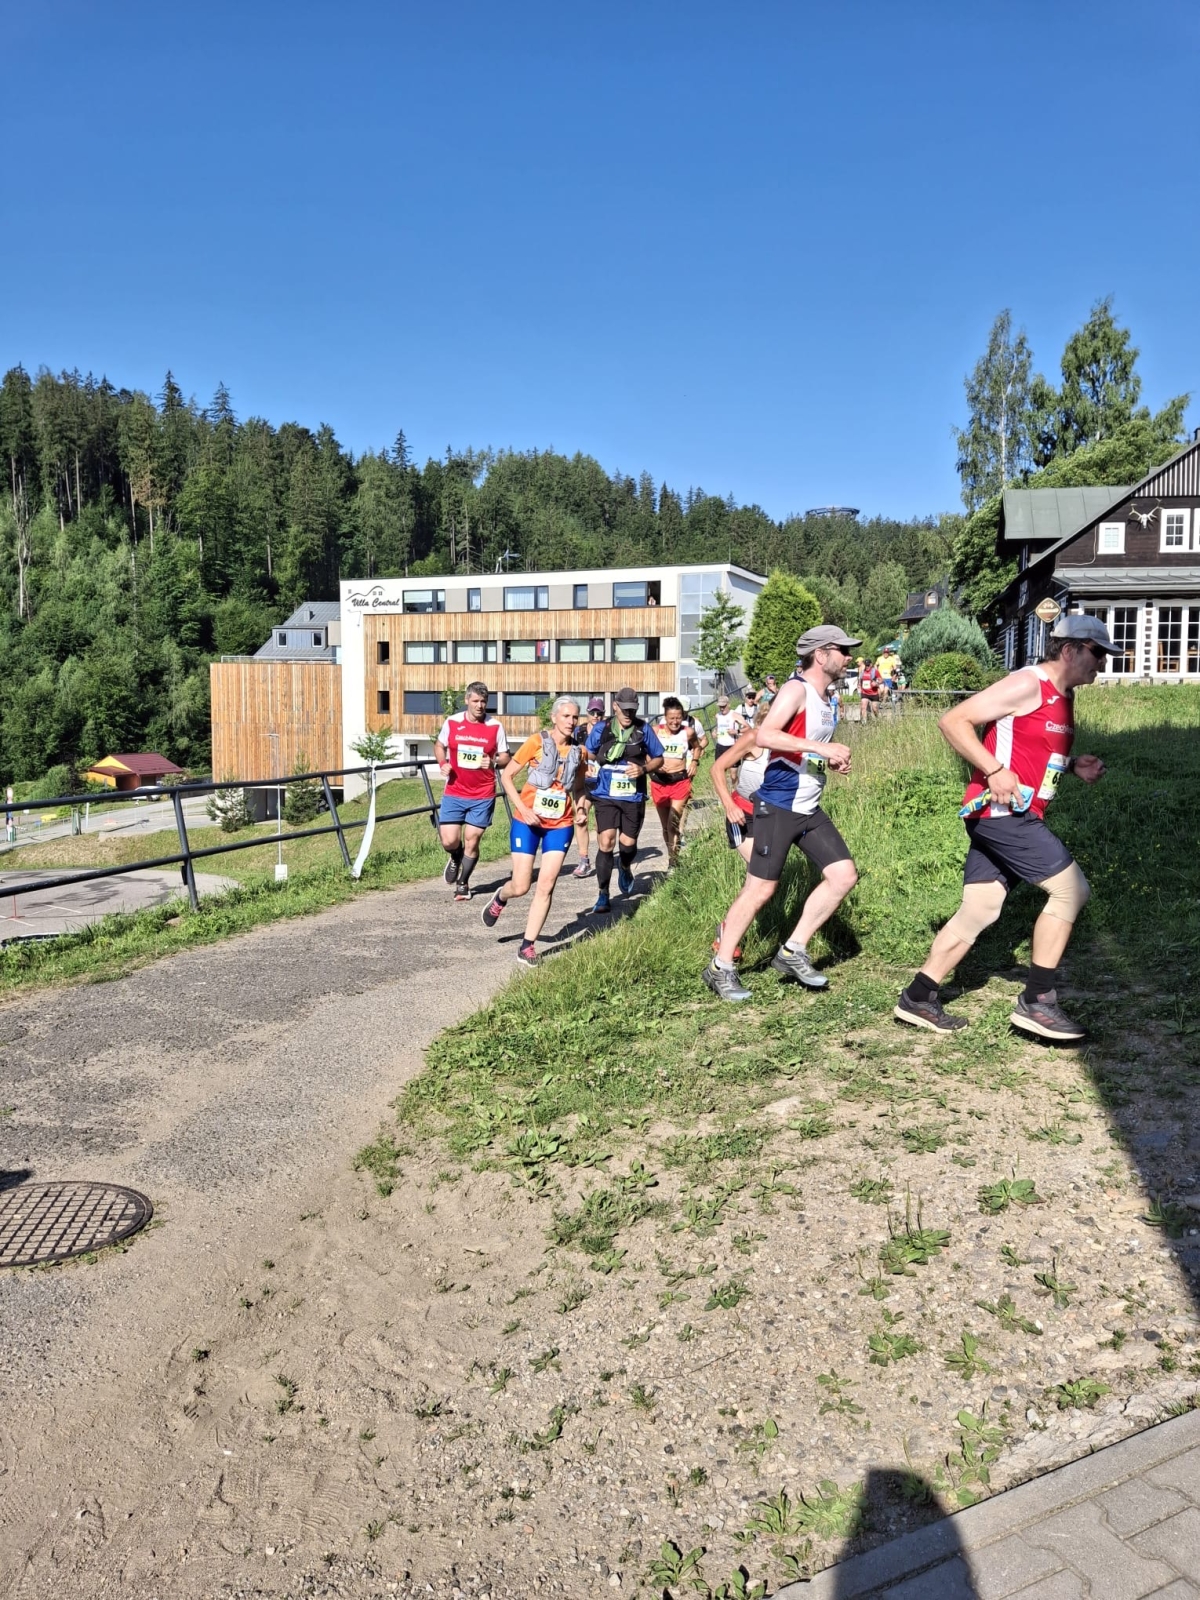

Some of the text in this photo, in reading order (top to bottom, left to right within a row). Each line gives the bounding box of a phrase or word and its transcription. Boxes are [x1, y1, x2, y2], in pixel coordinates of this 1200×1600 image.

[351, 597, 400, 607] Villa Central
[463, 752, 477, 761] 702
[616, 781, 630, 789] 331
